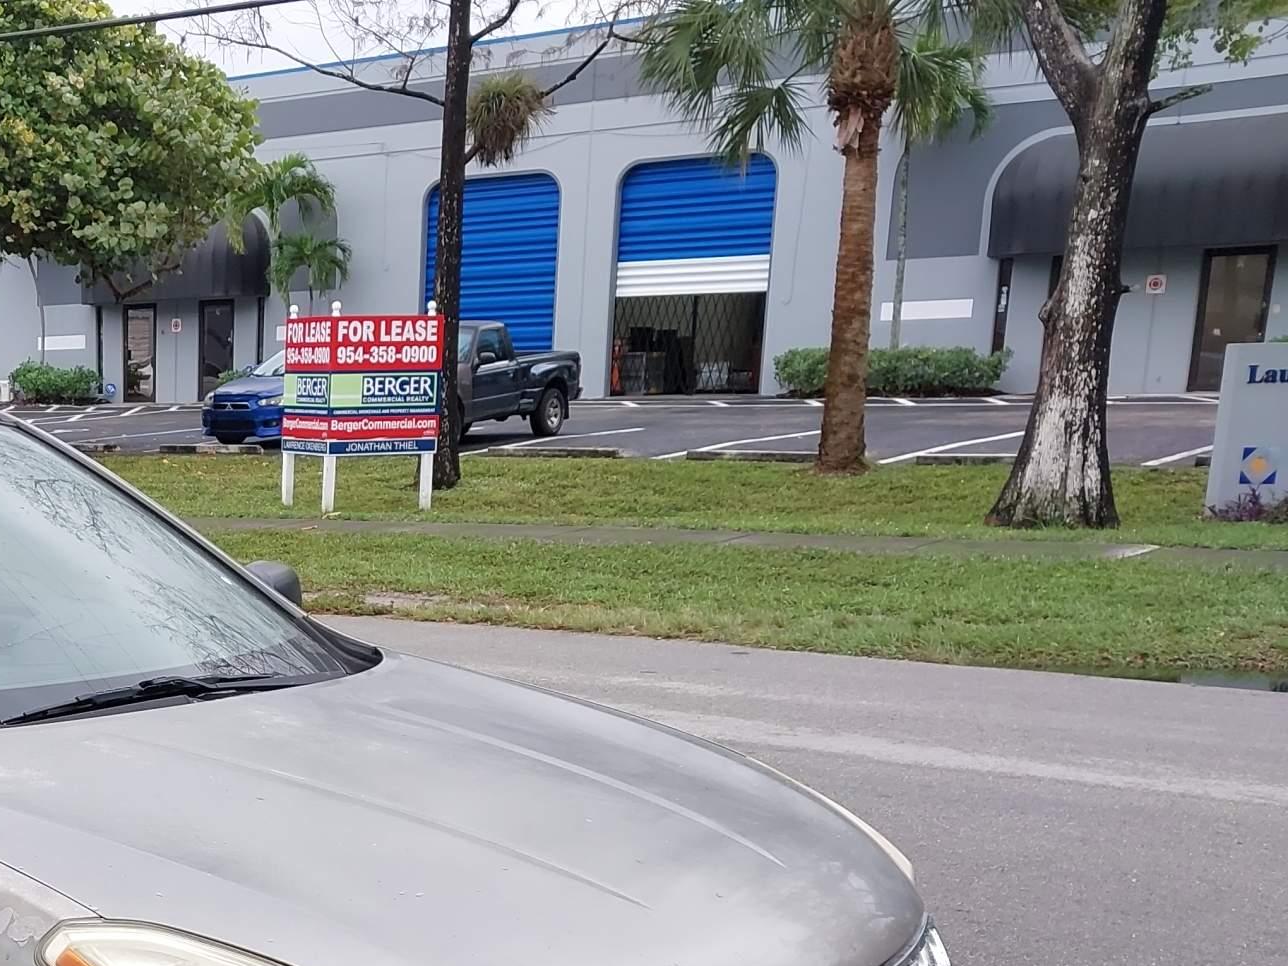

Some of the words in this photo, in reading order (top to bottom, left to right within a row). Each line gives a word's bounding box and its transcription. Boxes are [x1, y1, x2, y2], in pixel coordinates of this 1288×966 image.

[287, 323, 303, 343] FOR
[305, 321, 331, 343] LEASE
[337, 321, 375, 342] FOR
[380, 320, 438, 342] LEASE
[286, 347, 330, 364] 954-358-0900
[337, 346, 437, 363] 954-358-0900
[1247, 364, 1288, 384] Lau
[297, 377, 328, 398] BERGER
[363, 376, 433, 397] BERGER
[331, 419, 436, 432] BergerCommercial.com
[345, 442, 392, 452] JONATHAN
[395, 441, 418, 450] THIEL
